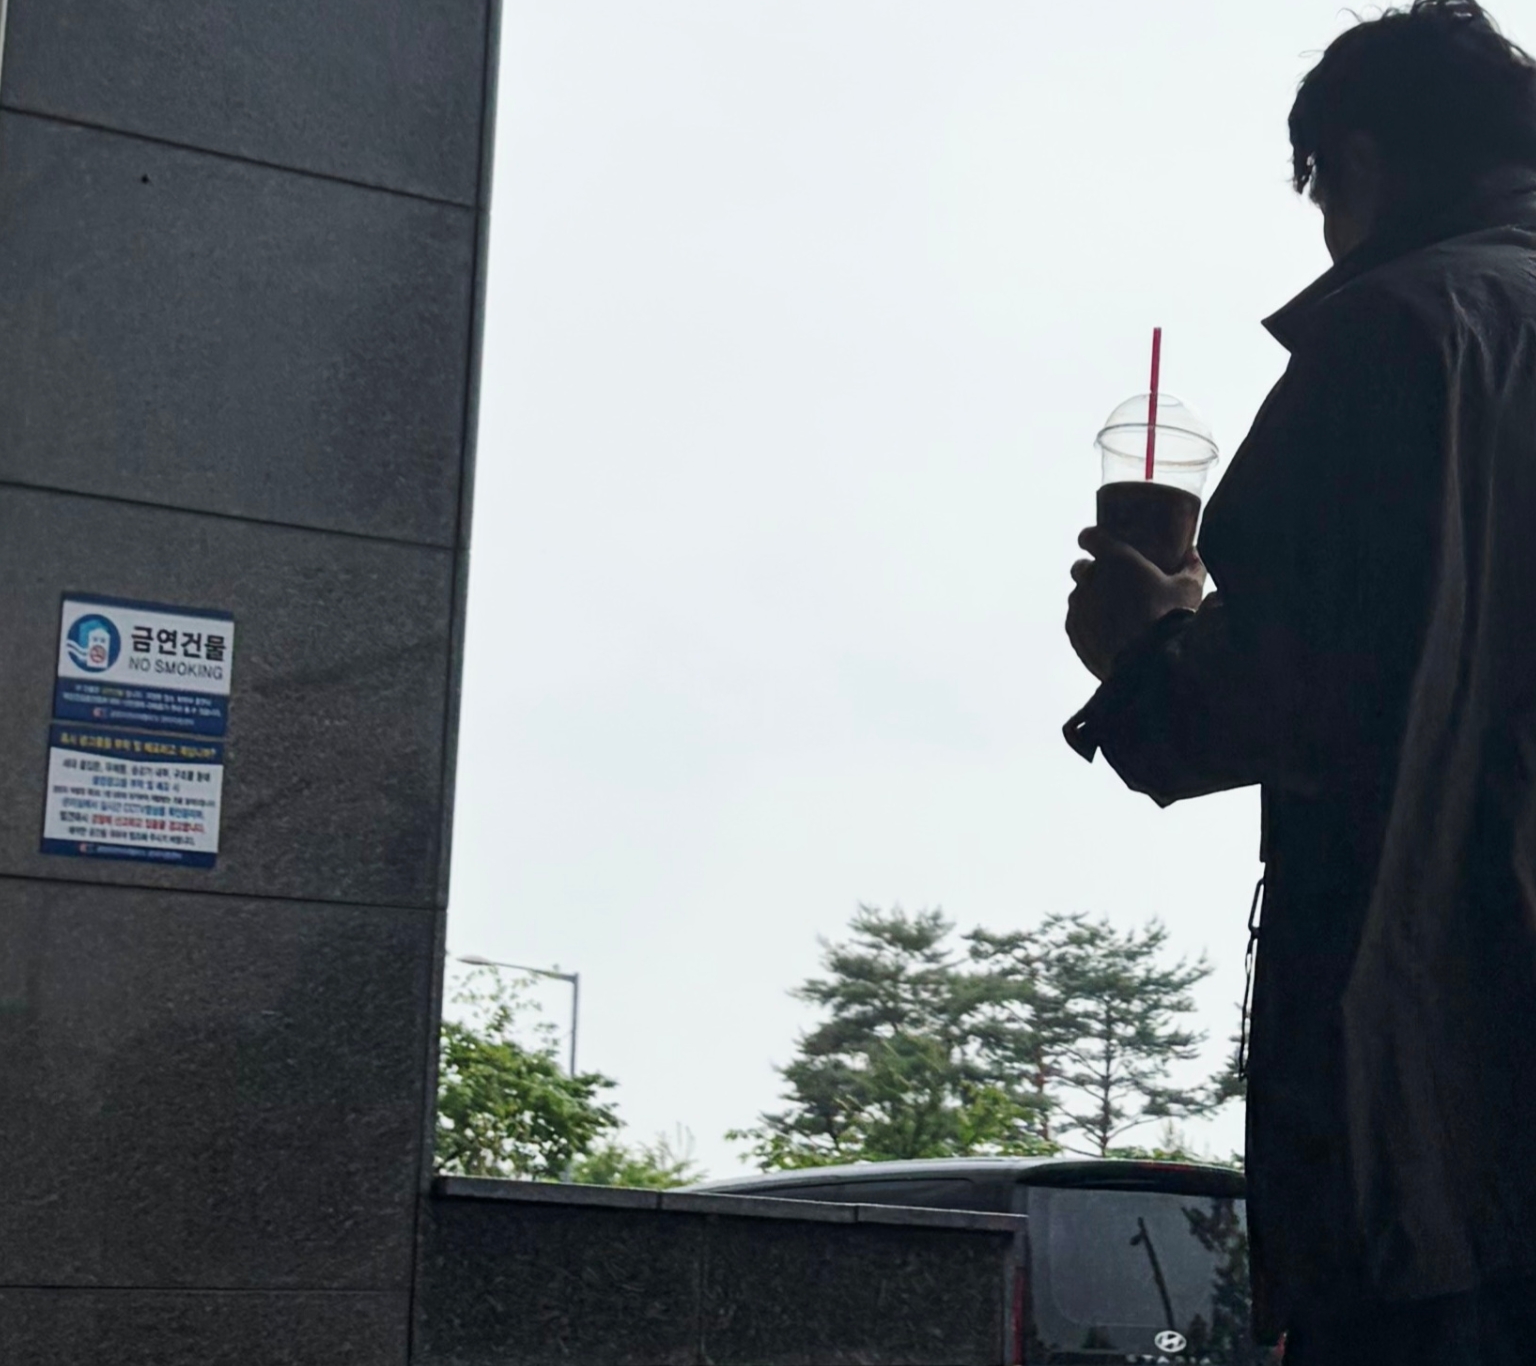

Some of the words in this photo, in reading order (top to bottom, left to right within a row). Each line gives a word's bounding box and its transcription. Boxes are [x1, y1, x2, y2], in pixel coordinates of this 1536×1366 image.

[131, 626, 226, 662] 금연건물
[129, 657, 150, 671] NO
[155, 659, 224, 680] SMOKING
